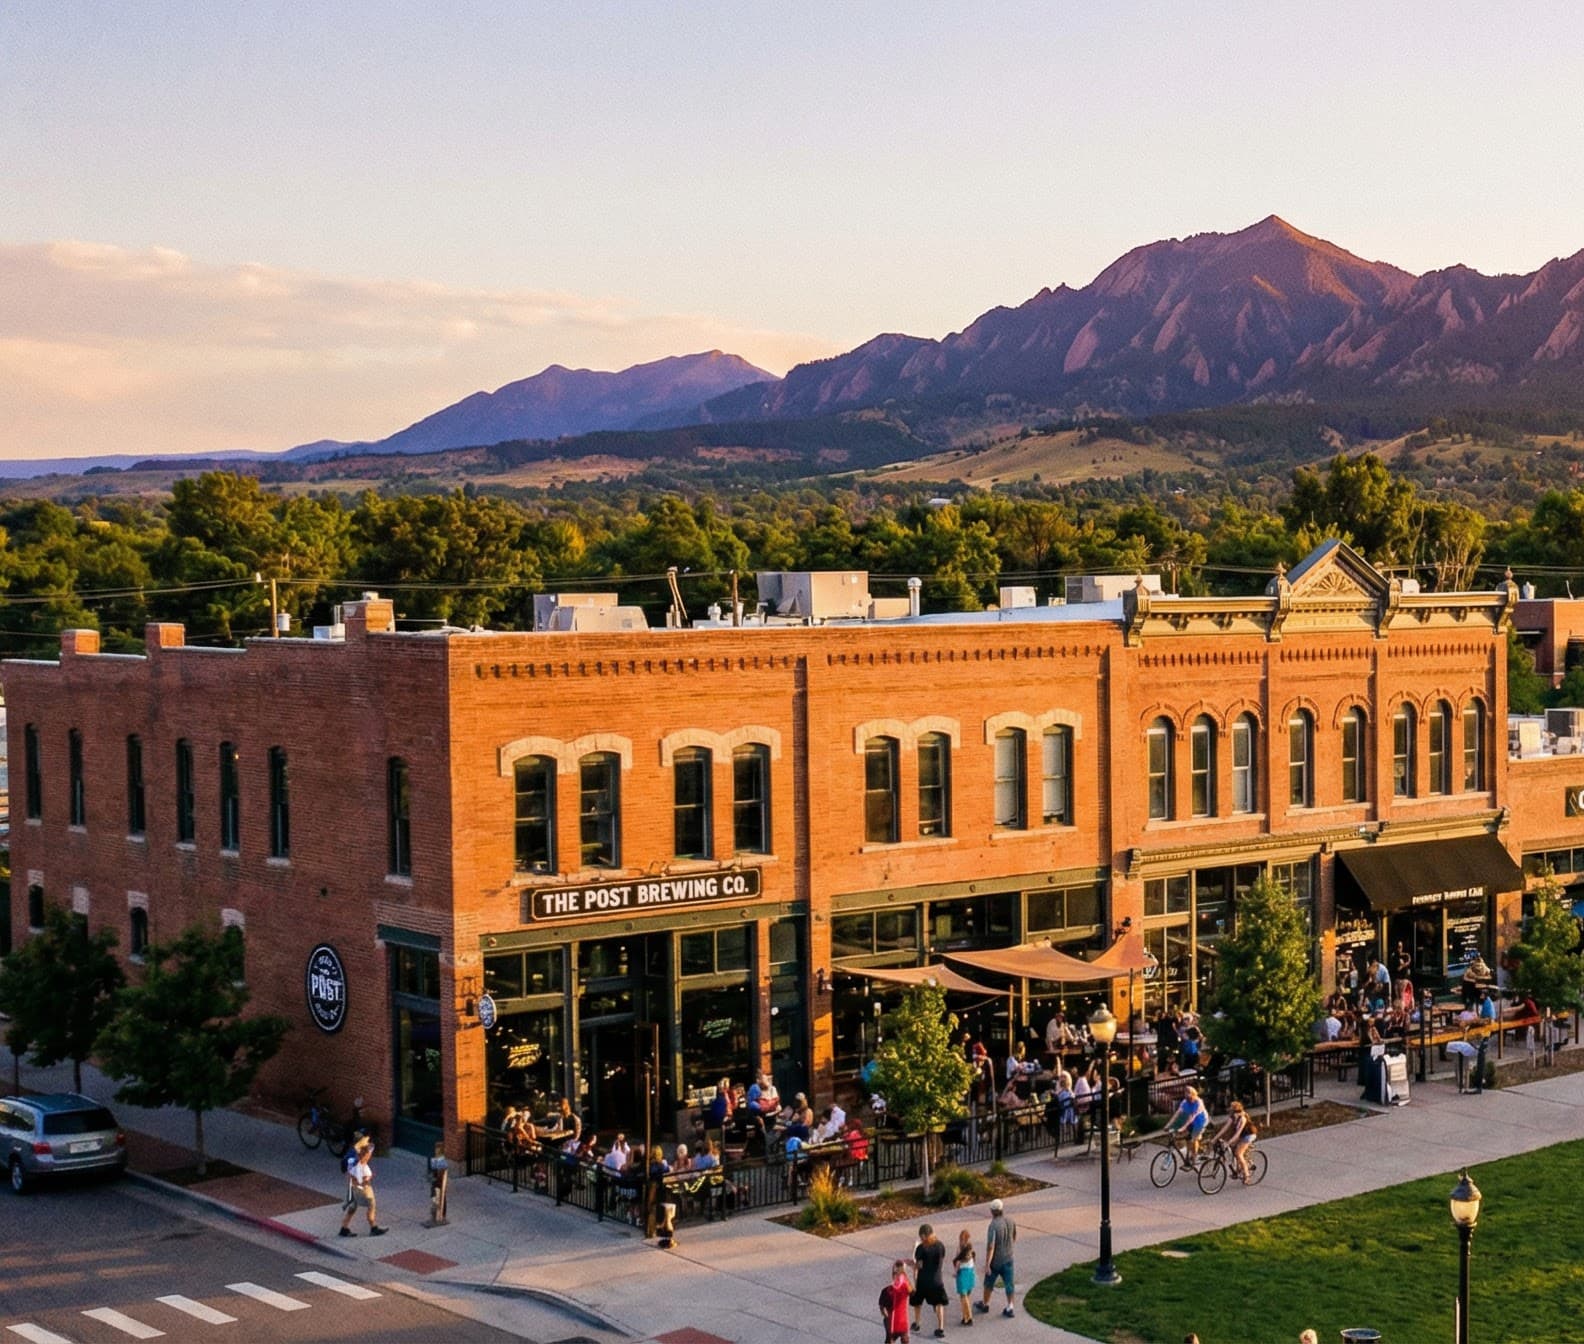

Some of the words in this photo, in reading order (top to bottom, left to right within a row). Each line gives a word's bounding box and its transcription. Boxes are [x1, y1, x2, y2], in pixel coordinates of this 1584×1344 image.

[542, 892, 579, 914] THE
[584, 887, 631, 909] POST
[637, 877, 718, 904] BREWING
[722, 876, 749, 894] CO.
